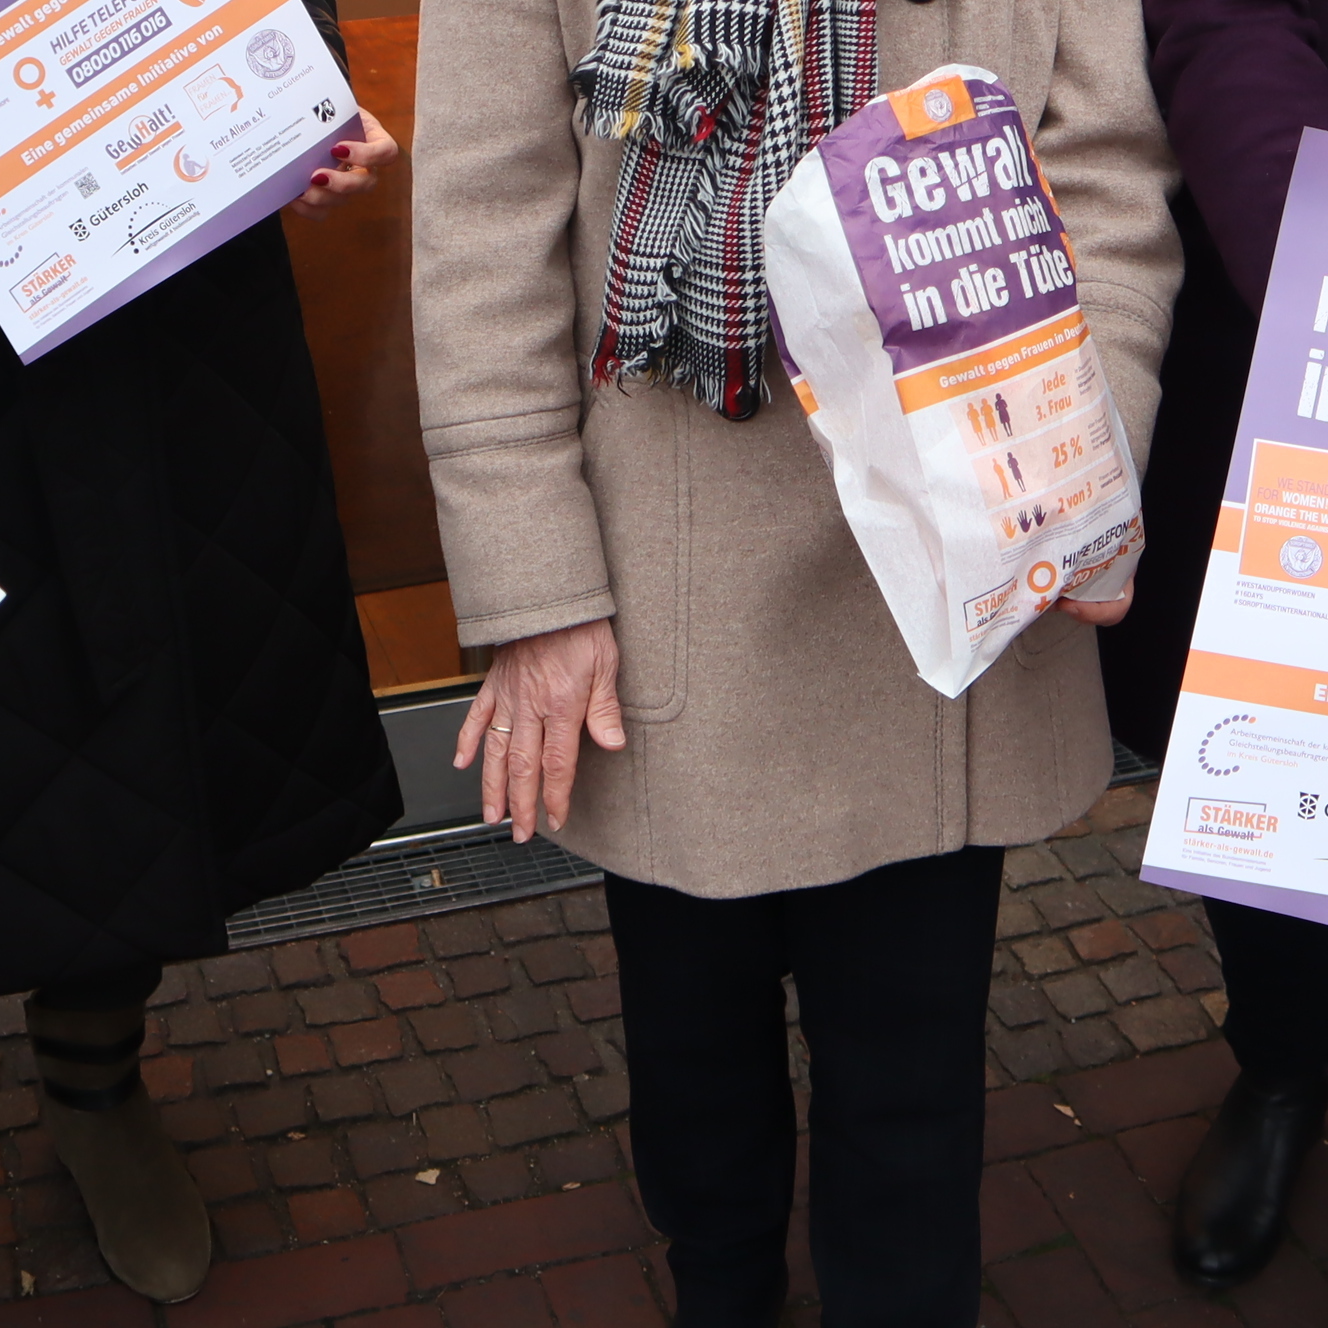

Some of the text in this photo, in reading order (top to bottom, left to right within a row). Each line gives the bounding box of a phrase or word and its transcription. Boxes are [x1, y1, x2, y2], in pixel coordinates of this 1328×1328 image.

[49, 18, 90, 54] HILFE
[71, 11, 166, 83] 08000 116 016
[20, 24, 223, 165] Eine gemeinsame Initiative von
[89, 182, 149, 226] Gütersloh
[137, 228, 159, 245] Kreis
[158, 202, 196, 231] Gütersloh
[884, 209, 1000, 275] kommt
[21, 253, 76, 297] STÄRKER
[899, 245, 1075, 332] in die Tüte
[1041, 373, 1066, 395] Jede
[1035, 393, 1073, 422] 3. Frau
[1051, 443, 1069, 469] 25
[1275, 475, 1295, 491] WE
[1256, 486, 1328, 509] FOR WOMEN!
[1253, 502, 1297, 519] ORANGE
[1298, 509, 1319, 522] THE
[1253, 515, 1262, 524] TO
[1262, 517, 1279, 525] STOP
[1277, 519, 1306, 530] VIOLENCE
[1229, 727, 1305, 747] Arbeitsgemeinschaft
[1306, 740, 1322, 750] der
[1196, 823, 1256, 841] als Gewalt
[1200, 804, 1278, 832] STÄRKER
[1183, 838, 1273, 858] stärker-als-gewalt.de
